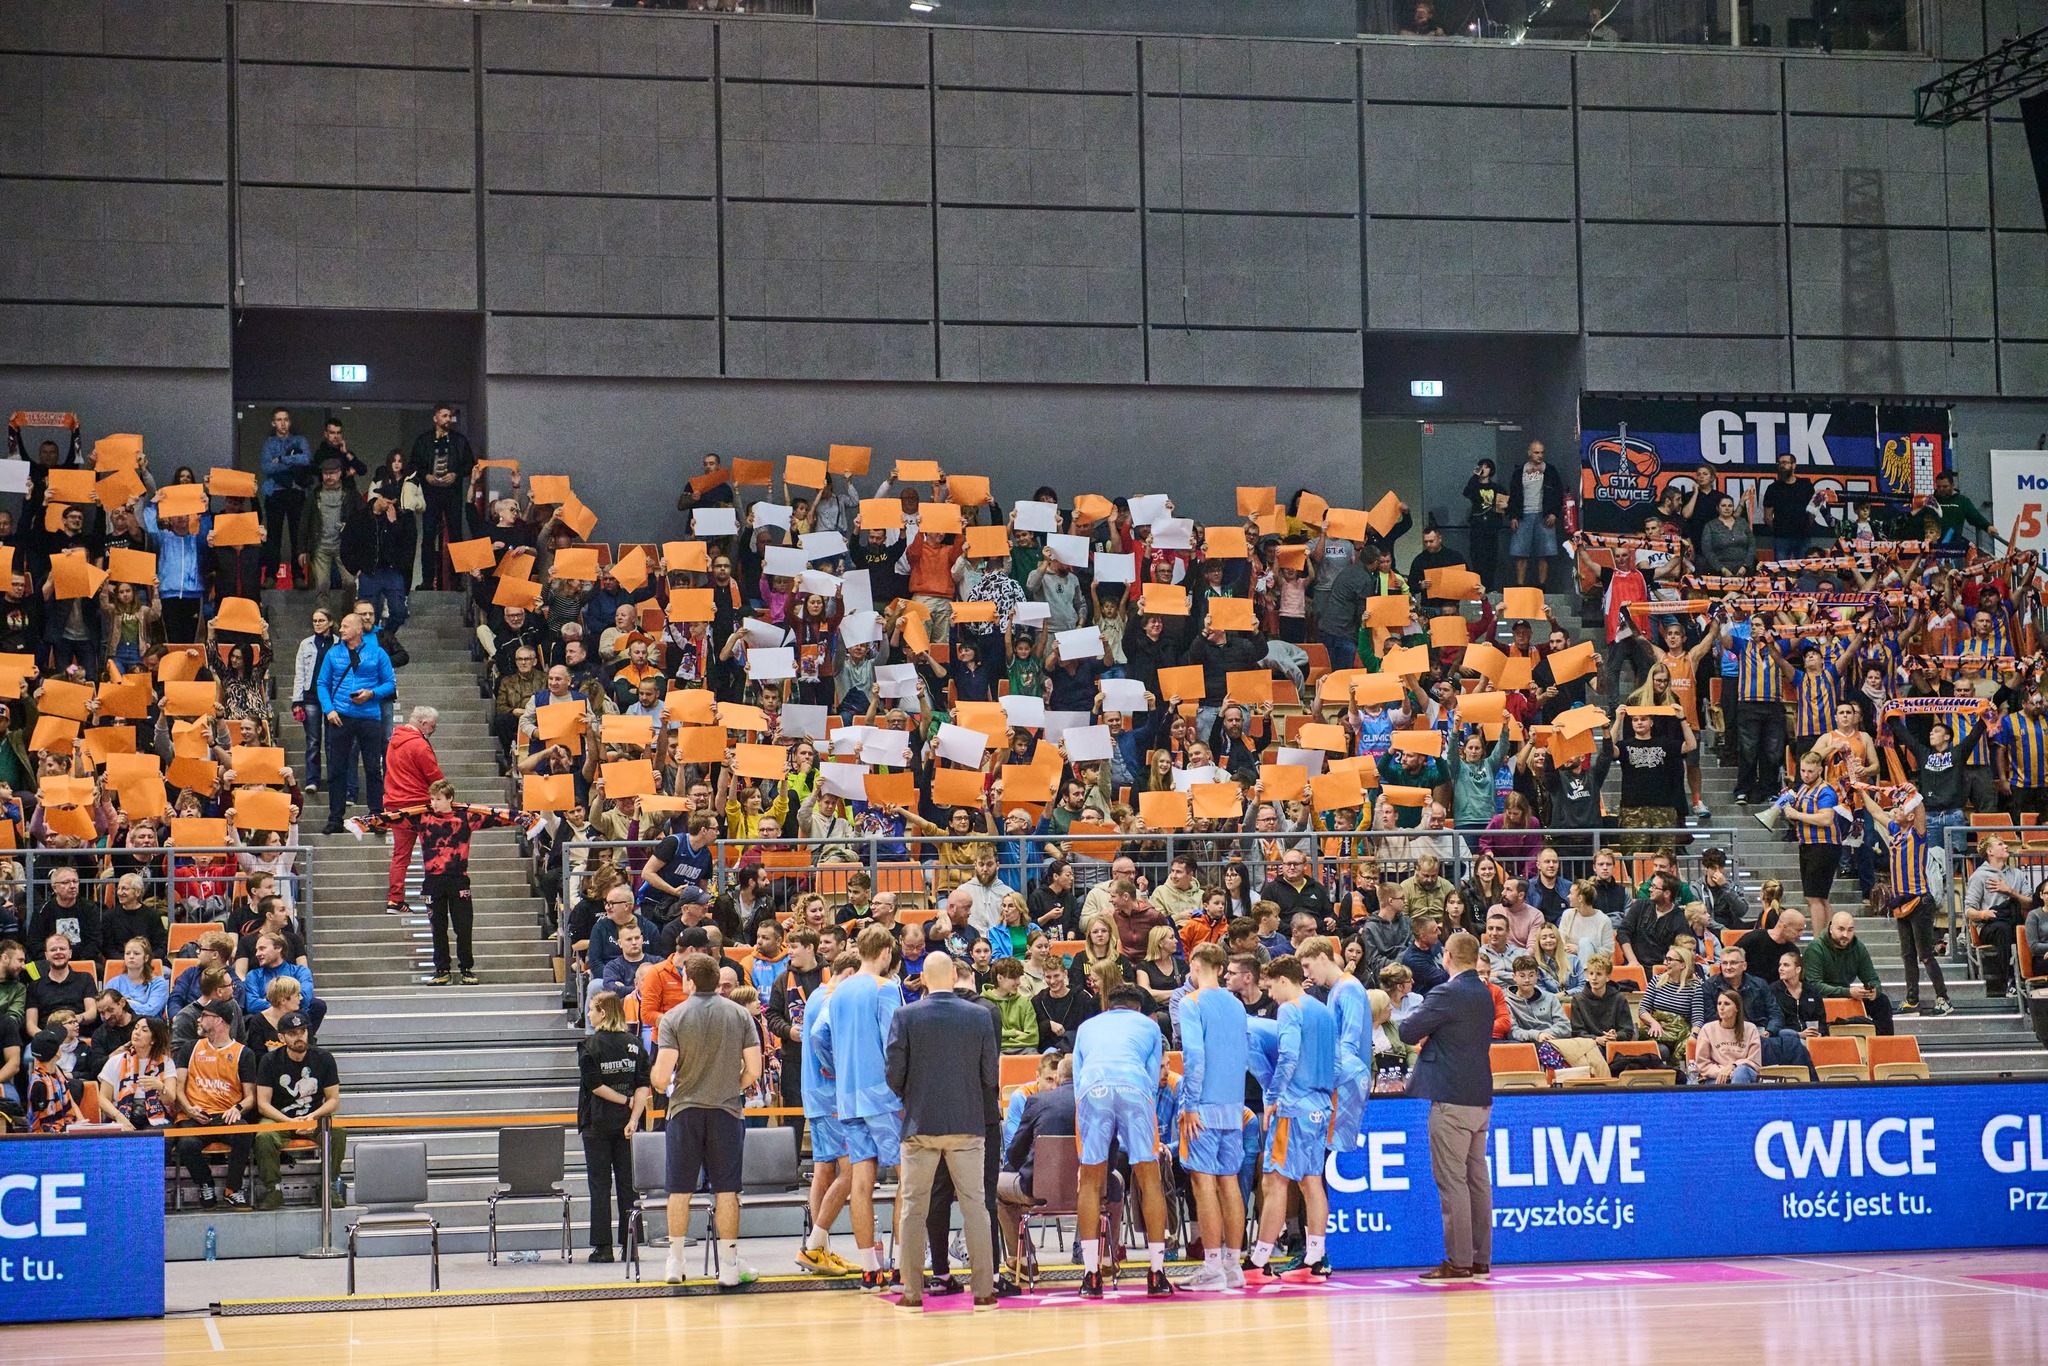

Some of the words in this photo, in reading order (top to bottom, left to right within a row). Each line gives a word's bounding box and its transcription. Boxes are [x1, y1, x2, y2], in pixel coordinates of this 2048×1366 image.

[1700, 410, 1834, 465] GTK
[1598, 487, 1650, 500] GLIWICE
[1609, 475, 1637, 488] GTK
[2019, 503, 2048, 538] 5
[1362, 734, 1392, 743] GLIWIC
[1487, 1125, 1646, 1188] LIWE
[0, 1173, 87, 1239] CE
[1356, 1208, 1392, 1232] tu.
[1491, 1197, 1609, 1232] rzyszłość
[1843, 1191, 1892, 1222] jest
[1898, 1191, 1932, 1214] tu.
[23, 1256, 64, 1281] tu.
